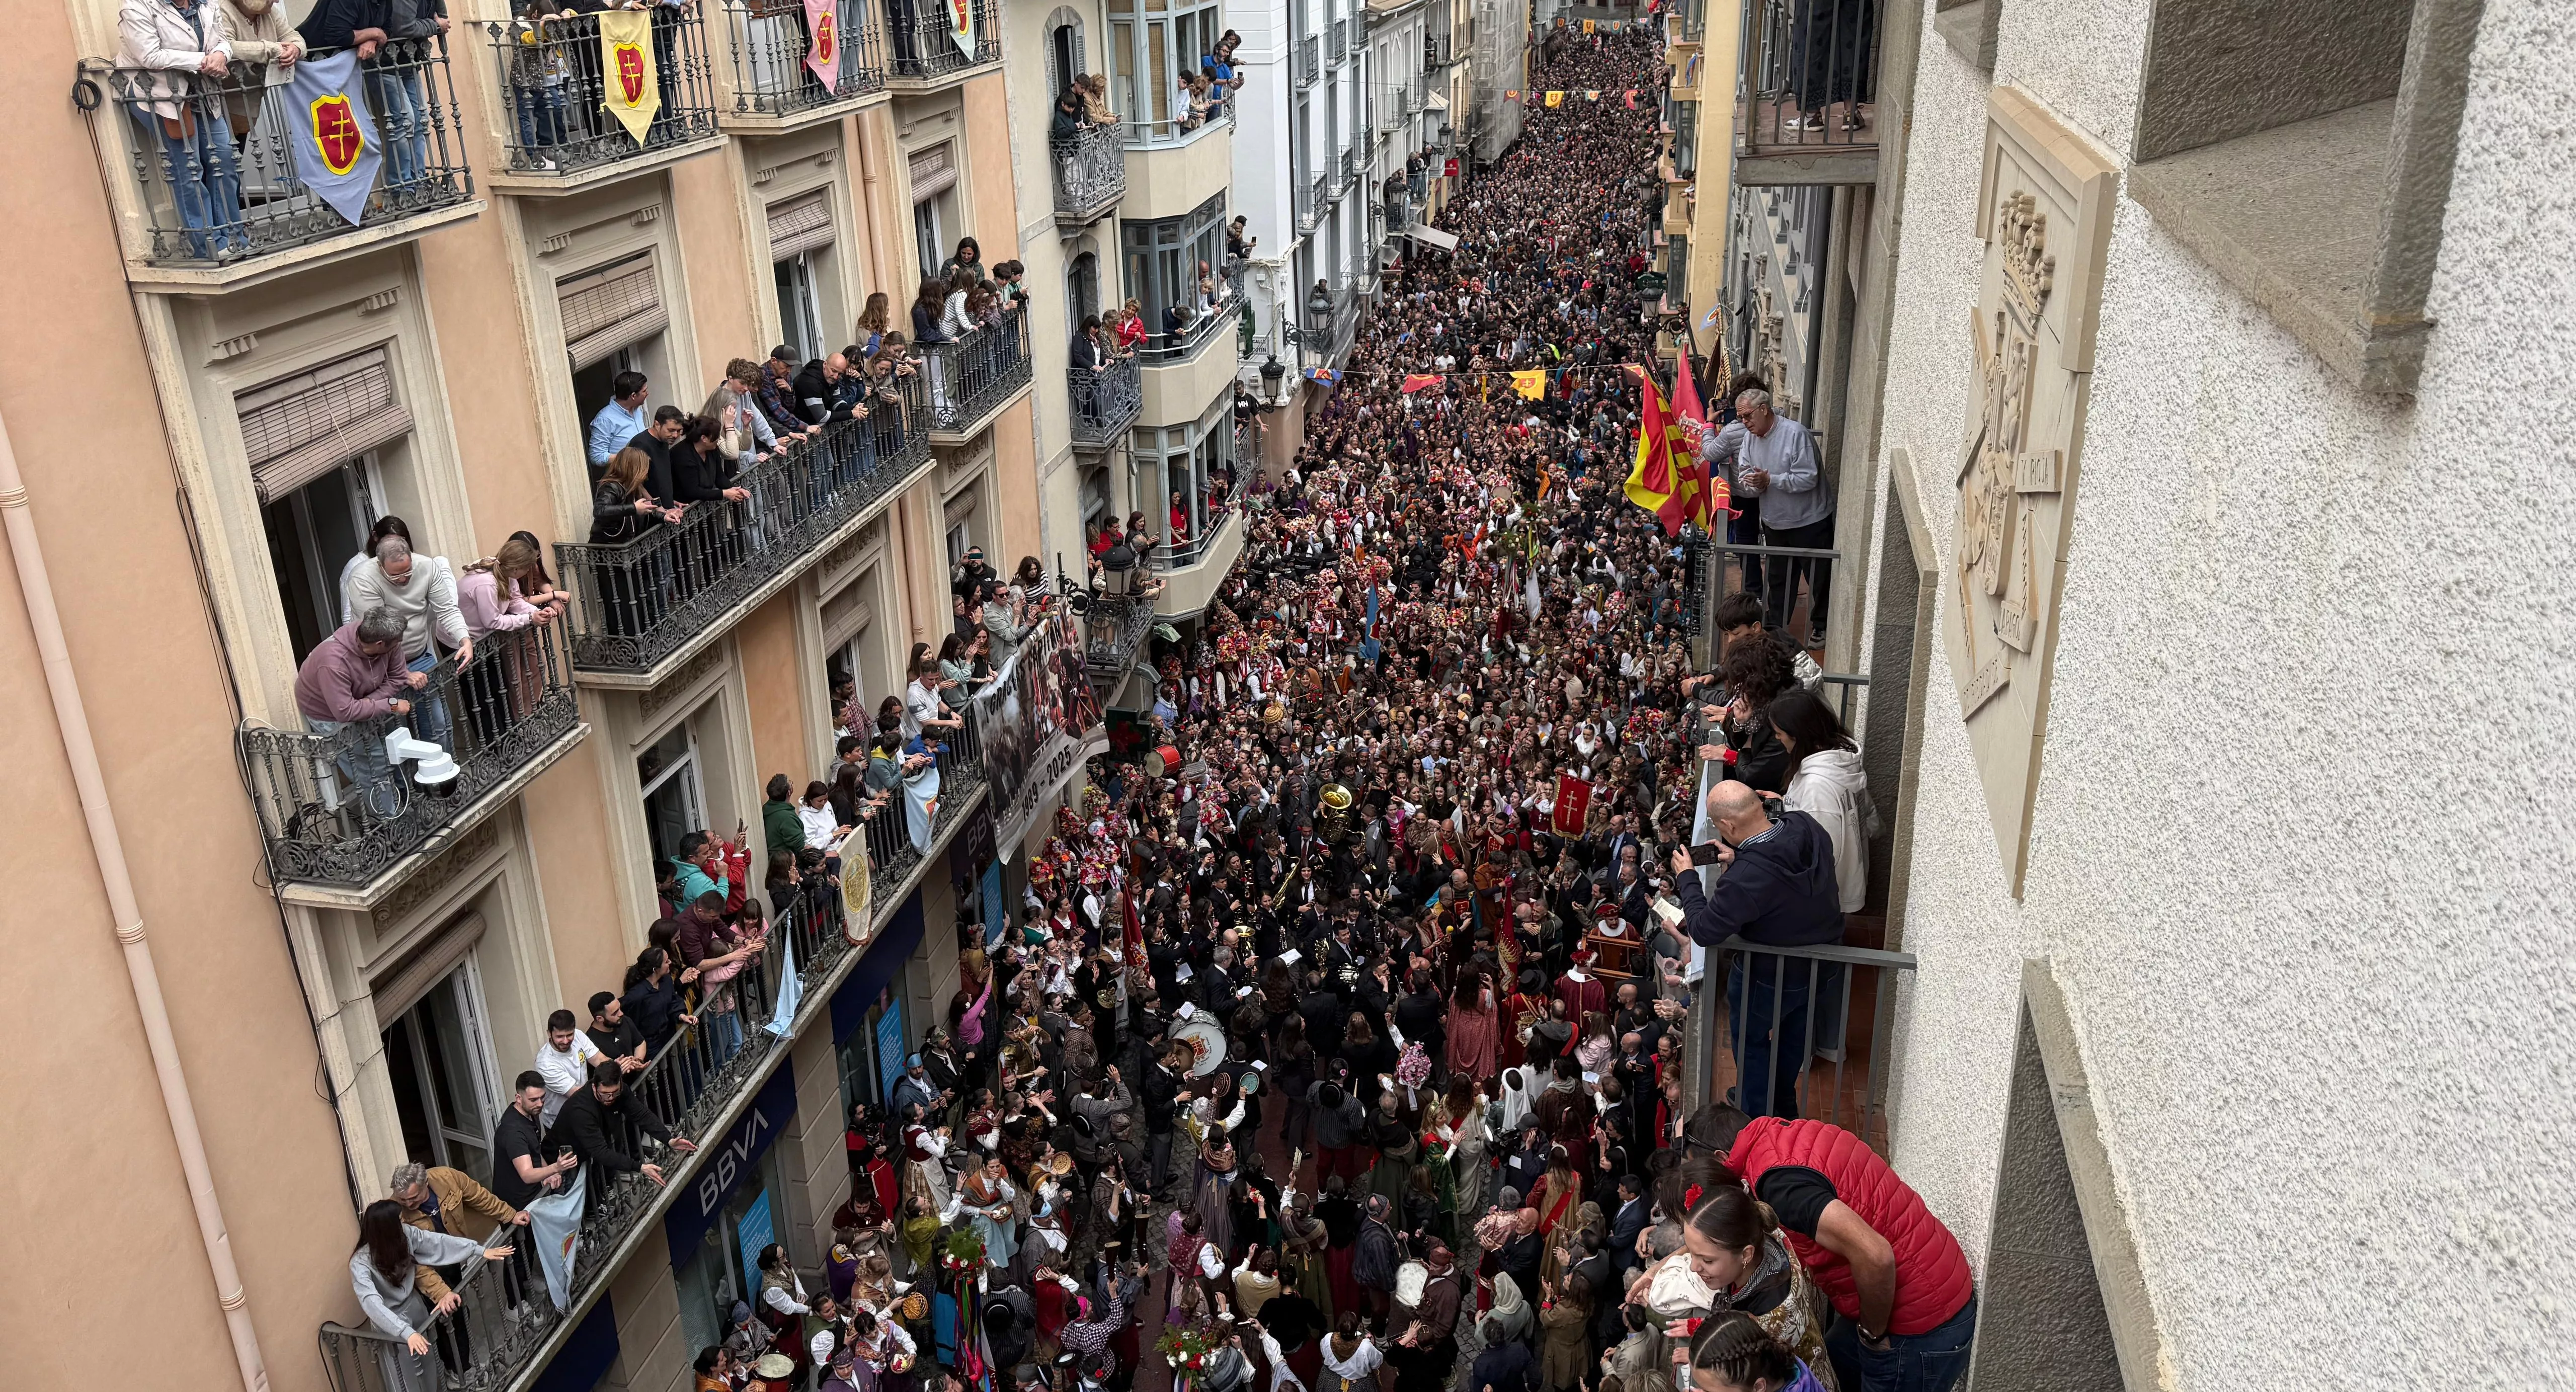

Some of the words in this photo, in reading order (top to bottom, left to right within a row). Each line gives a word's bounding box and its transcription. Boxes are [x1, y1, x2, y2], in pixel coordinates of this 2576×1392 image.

[2021, 459, 2027, 486] Y
[1022, 781, 1038, 822] 1989
[1046, 744, 1072, 786] 2025
[699, 1107, 769, 1217] BBVA
